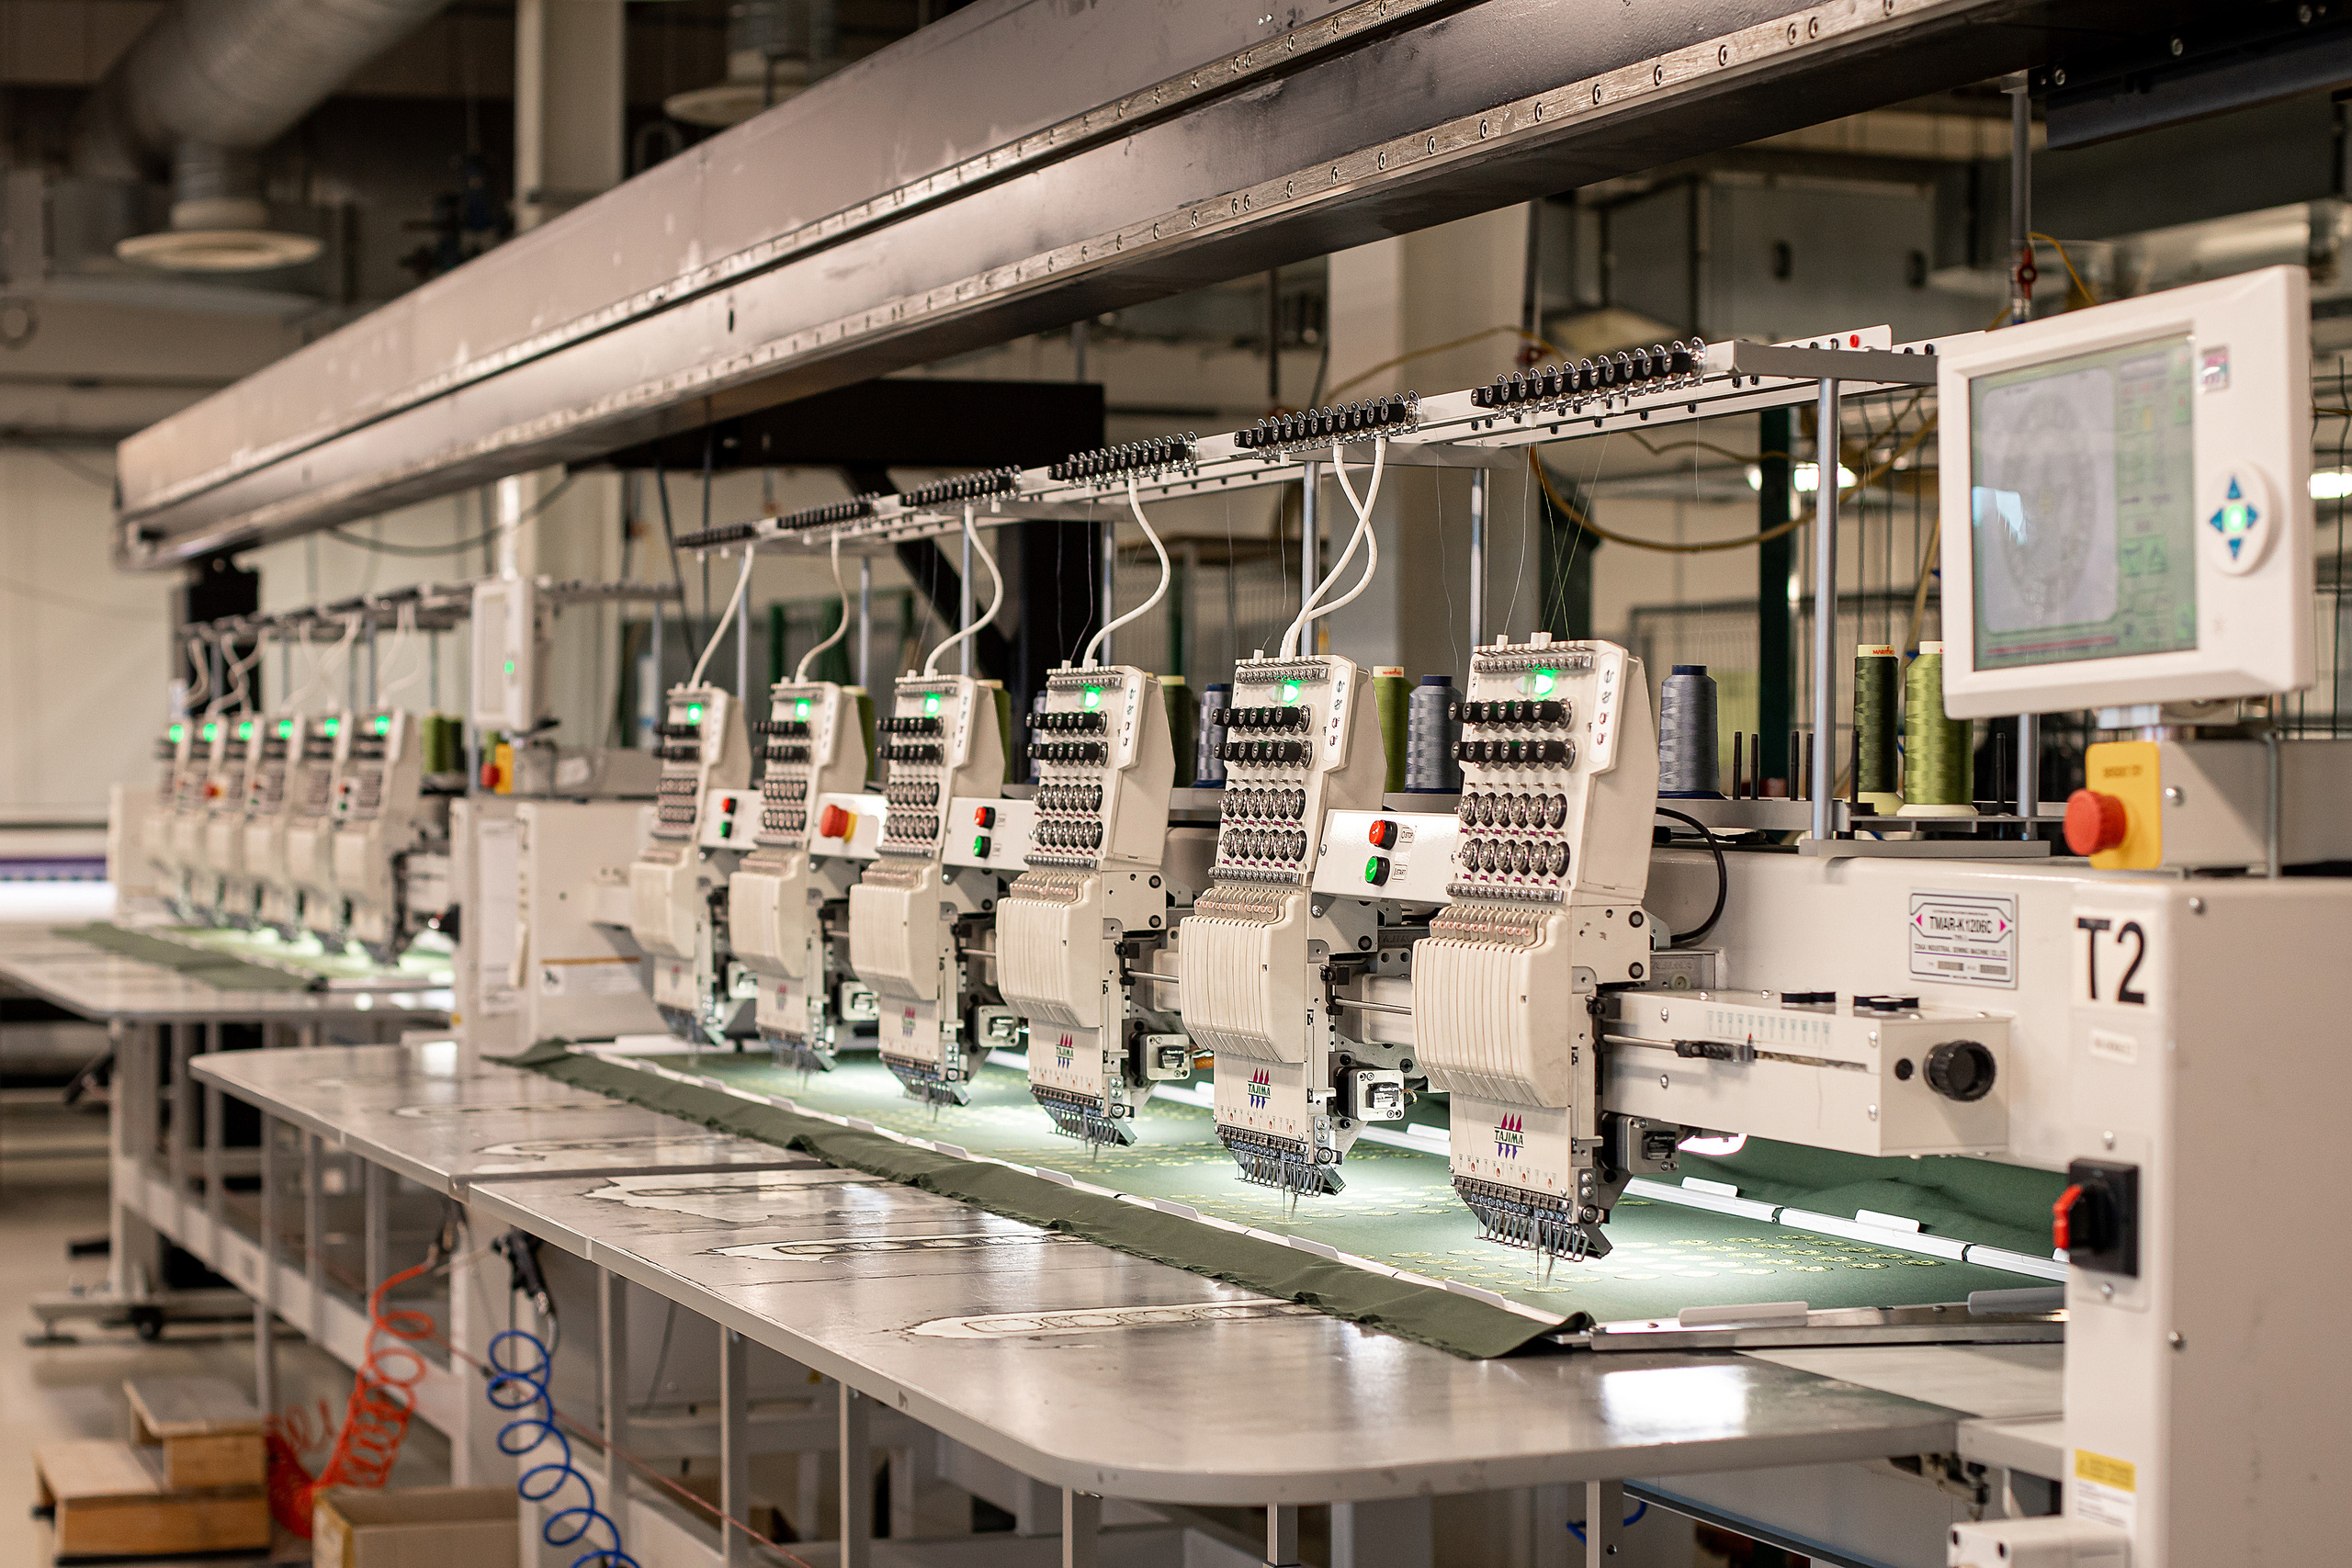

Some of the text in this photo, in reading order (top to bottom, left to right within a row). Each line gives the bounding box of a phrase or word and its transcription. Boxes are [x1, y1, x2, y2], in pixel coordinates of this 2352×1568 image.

[2077, 917, 2145, 1005] T2
[1248, 1083, 1271, 1096] TAJIMA
[1495, 1130, 1523, 1145] TAJIMA
